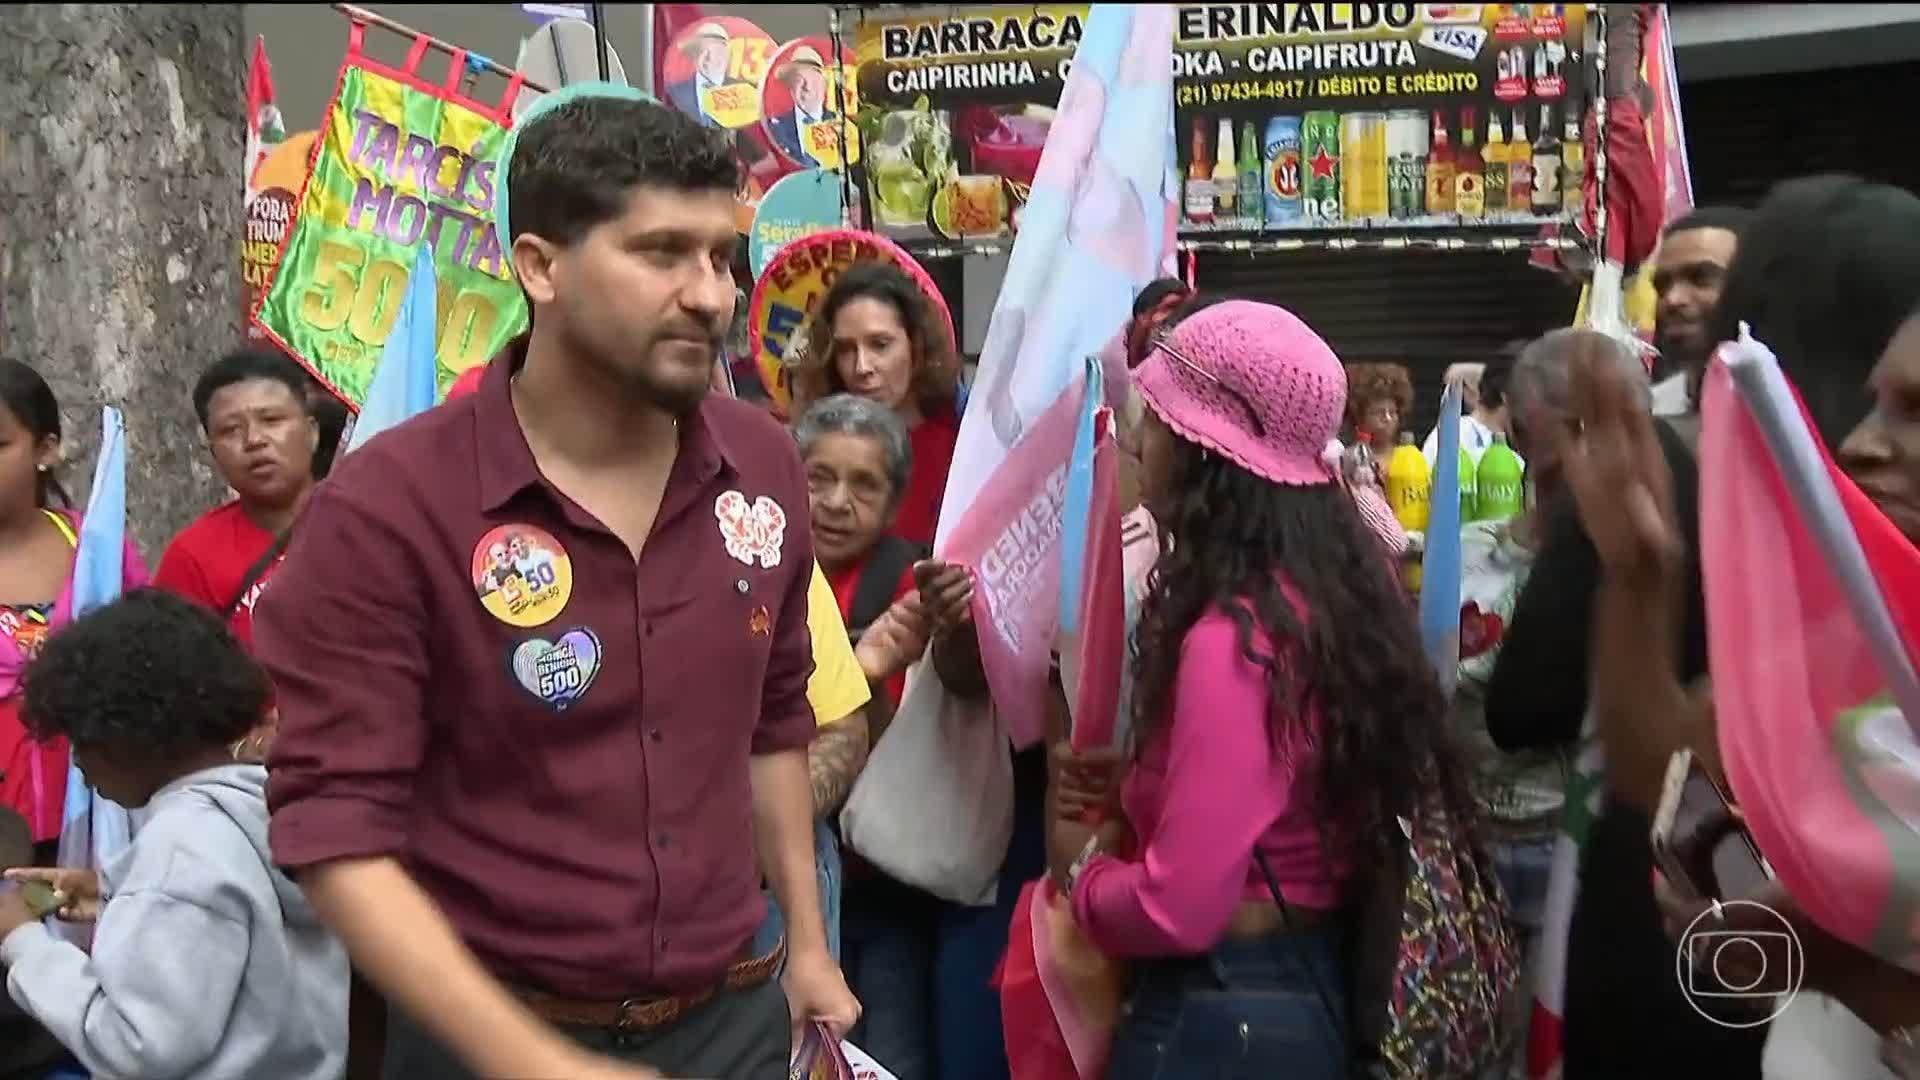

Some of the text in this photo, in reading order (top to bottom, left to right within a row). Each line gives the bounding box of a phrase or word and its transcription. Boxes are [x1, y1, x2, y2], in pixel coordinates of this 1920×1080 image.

[882, 4, 1415, 60] BARRACA ERINALDO
[1433, 26, 1477, 52] VISA
[727, 37, 768, 80] 13
[886, 62, 1036, 94] CAIPIRINHA
[1247, 40, 1417, 73] CAIPIFRUTA
[1176, 84, 1206, 107] (21)
[1211, 79, 1304, 101] 97434-4917
[1317, 74, 1382, 97] DÉBITO
[1385, 76, 1397, 94] E
[1401, 68, 1479, 94] CRÉDITO
[253, 196, 290, 222] FORA
[300, 240, 499, 376] 500
[525, 562, 555, 592] 50
[539, 666, 580, 698] 500
